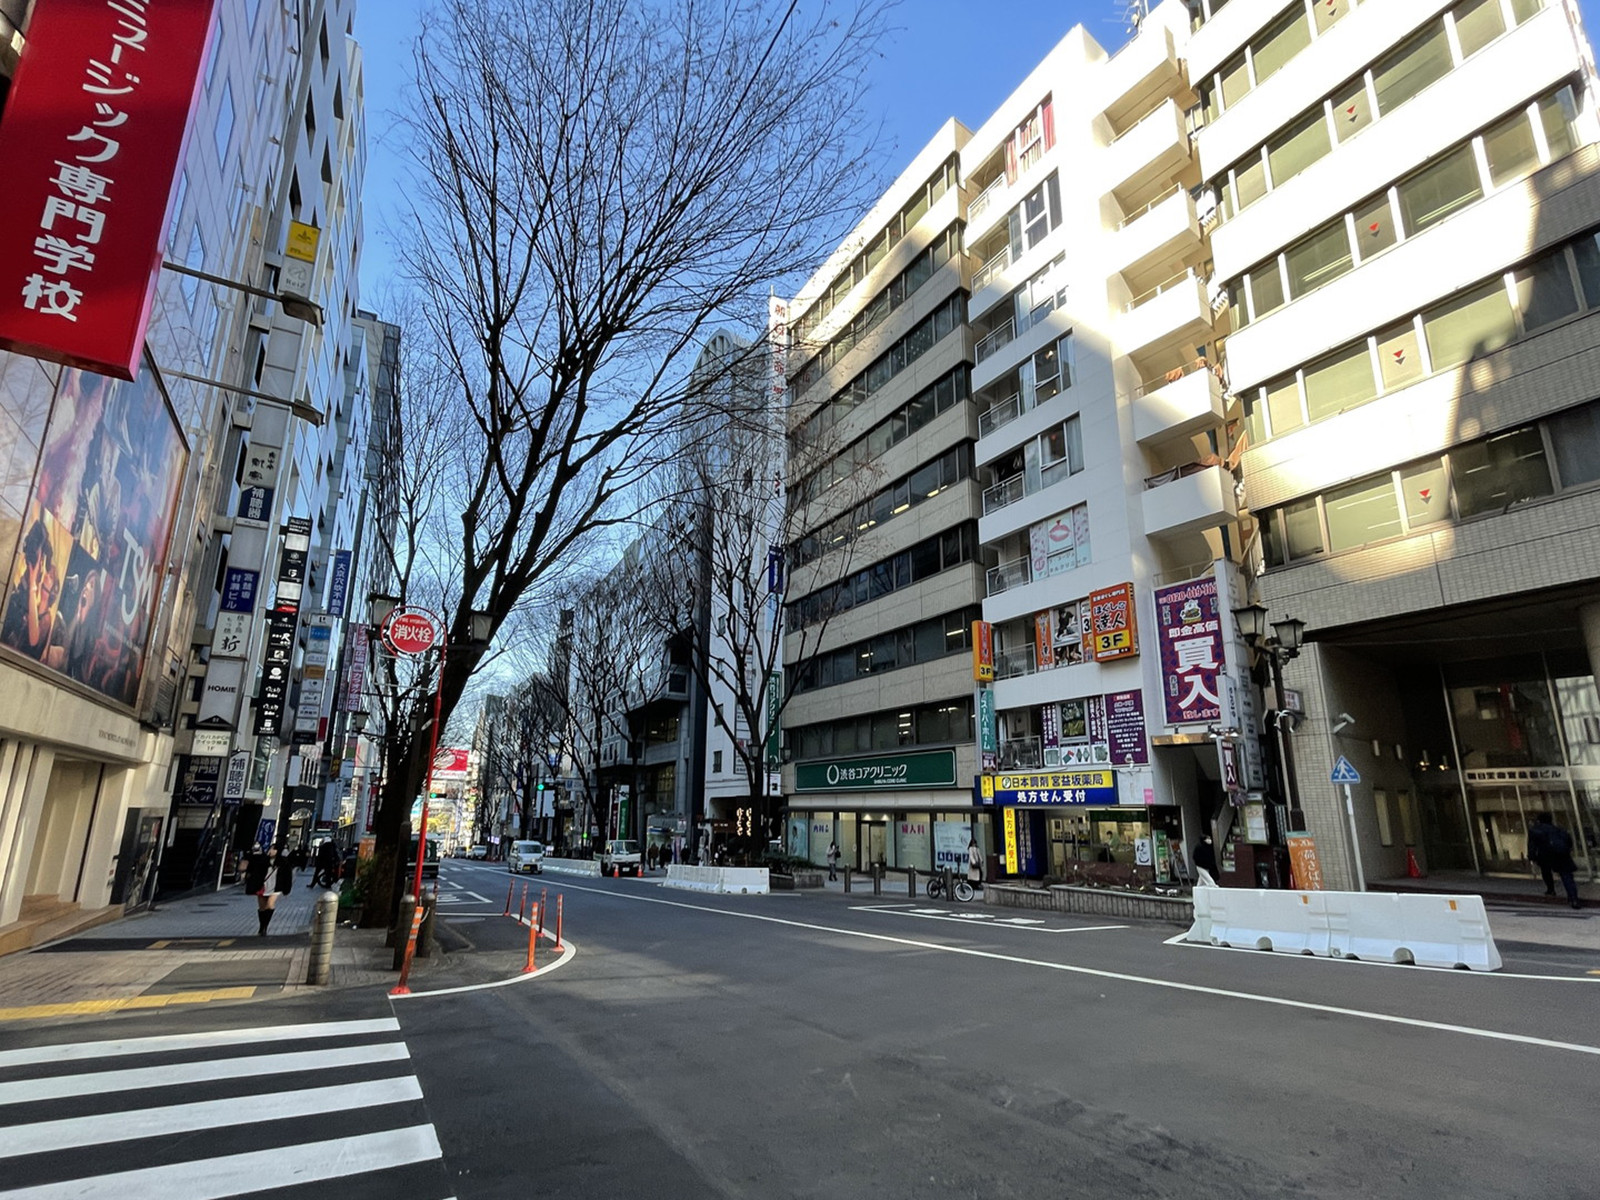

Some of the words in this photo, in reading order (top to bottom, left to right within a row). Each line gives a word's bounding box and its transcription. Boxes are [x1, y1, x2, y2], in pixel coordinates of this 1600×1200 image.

[22, 0, 149, 321] ミュージック専門学校
[248, 487, 265, 518] 補聴器
[241, 573, 254, 599] 宮益坂
[330, 563, 346, 614] 大京穴吹不動産
[394, 623, 432, 643] 消火栓
[1169, 620, 1218, 638] 即金高価
[1101, 633, 1124, 648] 3F
[980, 667, 991, 675] 3F
[1174, 635, 1220, 710] 買入
[208, 685, 236, 693] HOMIE
[227, 758, 246, 795] 補聴器
[840, 764, 907, 781] 渋谷コアクリニック
[1012, 775, 1049, 788] 日本調剤
[1051, 773, 1103, 787] 宮益坂薬局
[1017, 789, 1086, 803] 処方せん受付
[1006, 810, 1015, 871] 処方せん受付
